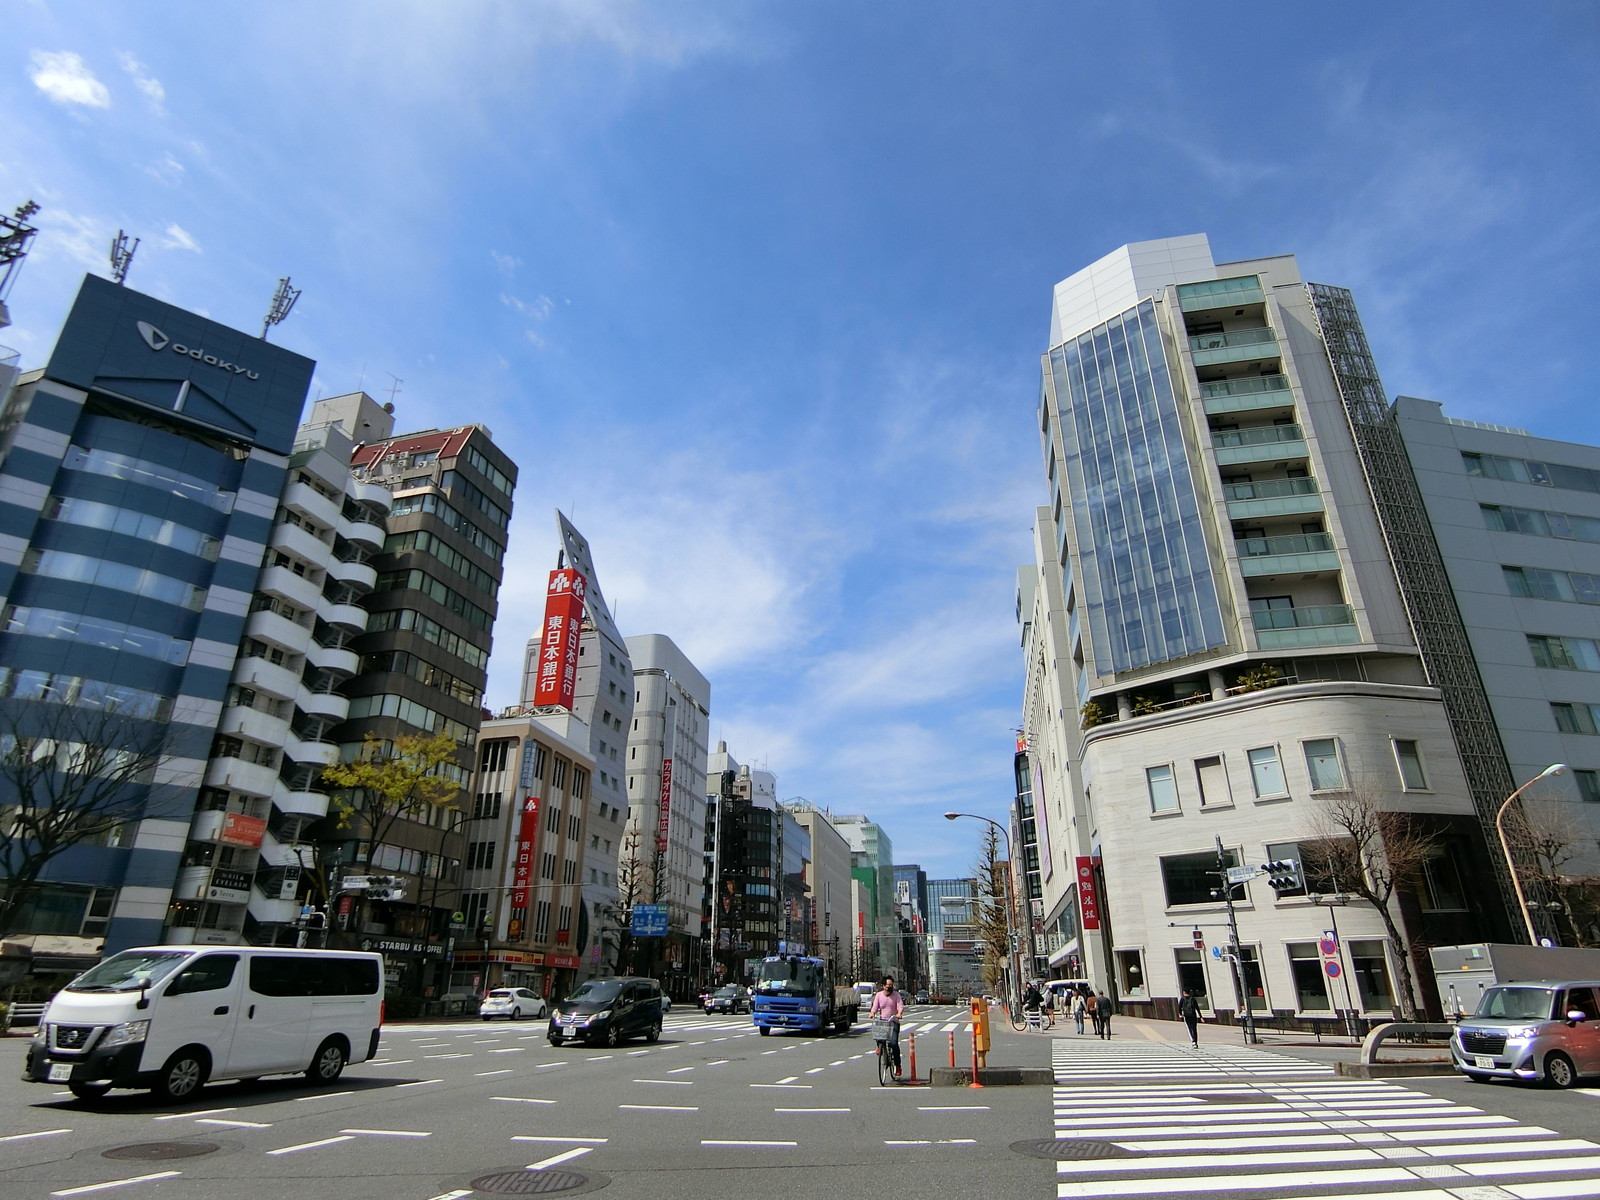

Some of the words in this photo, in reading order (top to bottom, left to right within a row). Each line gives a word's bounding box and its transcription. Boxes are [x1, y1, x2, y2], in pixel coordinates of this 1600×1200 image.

[172, 343, 260, 380] odakyu
[540, 615, 564, 693] 東日本銀行
[562, 618, 579, 696] 東日本銀行
[514, 841, 531, 903] 東日本銀行
[379, 941, 423, 952] STARBUKS
